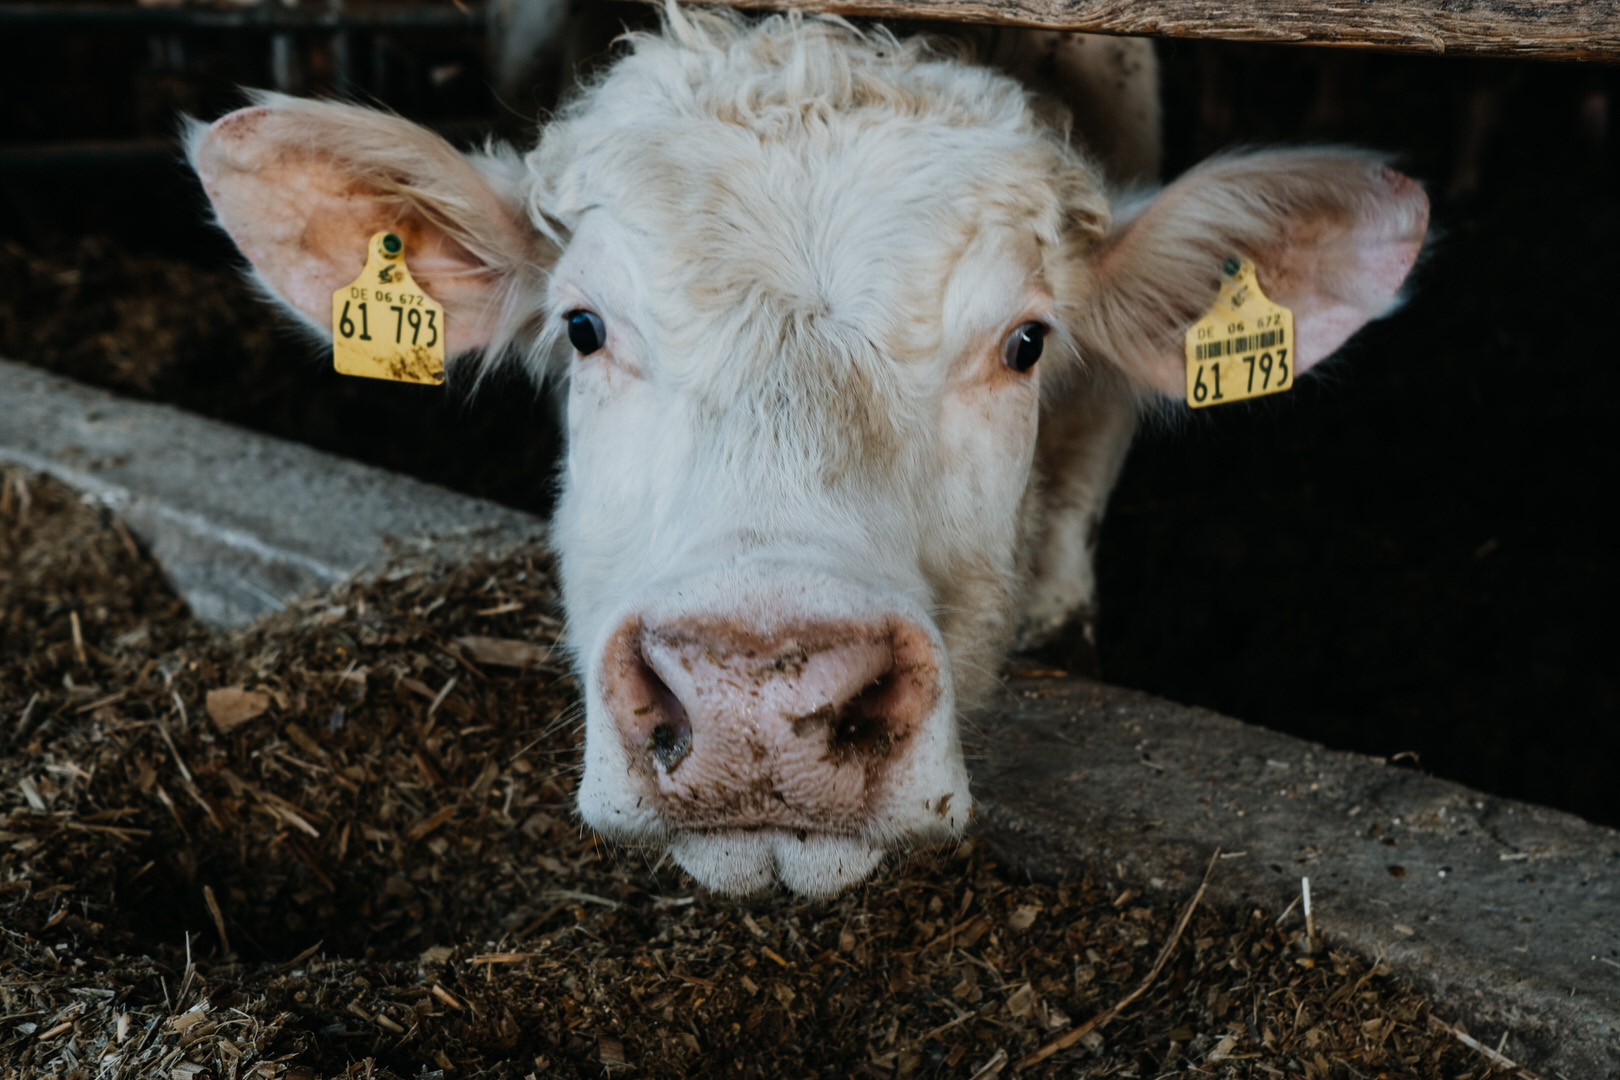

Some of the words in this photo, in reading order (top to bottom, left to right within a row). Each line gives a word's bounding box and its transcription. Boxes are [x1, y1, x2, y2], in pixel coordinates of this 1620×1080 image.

[351, 287, 368, 300] DE
[375, 290, 392, 303] 06
[400, 294, 424, 306] 672
[339, 300, 372, 341] 61
[390, 305, 438, 348] 793
[1197, 326, 1214, 339] DE
[1228, 322, 1245, 334] 06
[1257, 314, 1281, 328] 672
[1193, 362, 1223, 402] 61
[1242, 349, 1288, 393] 793
